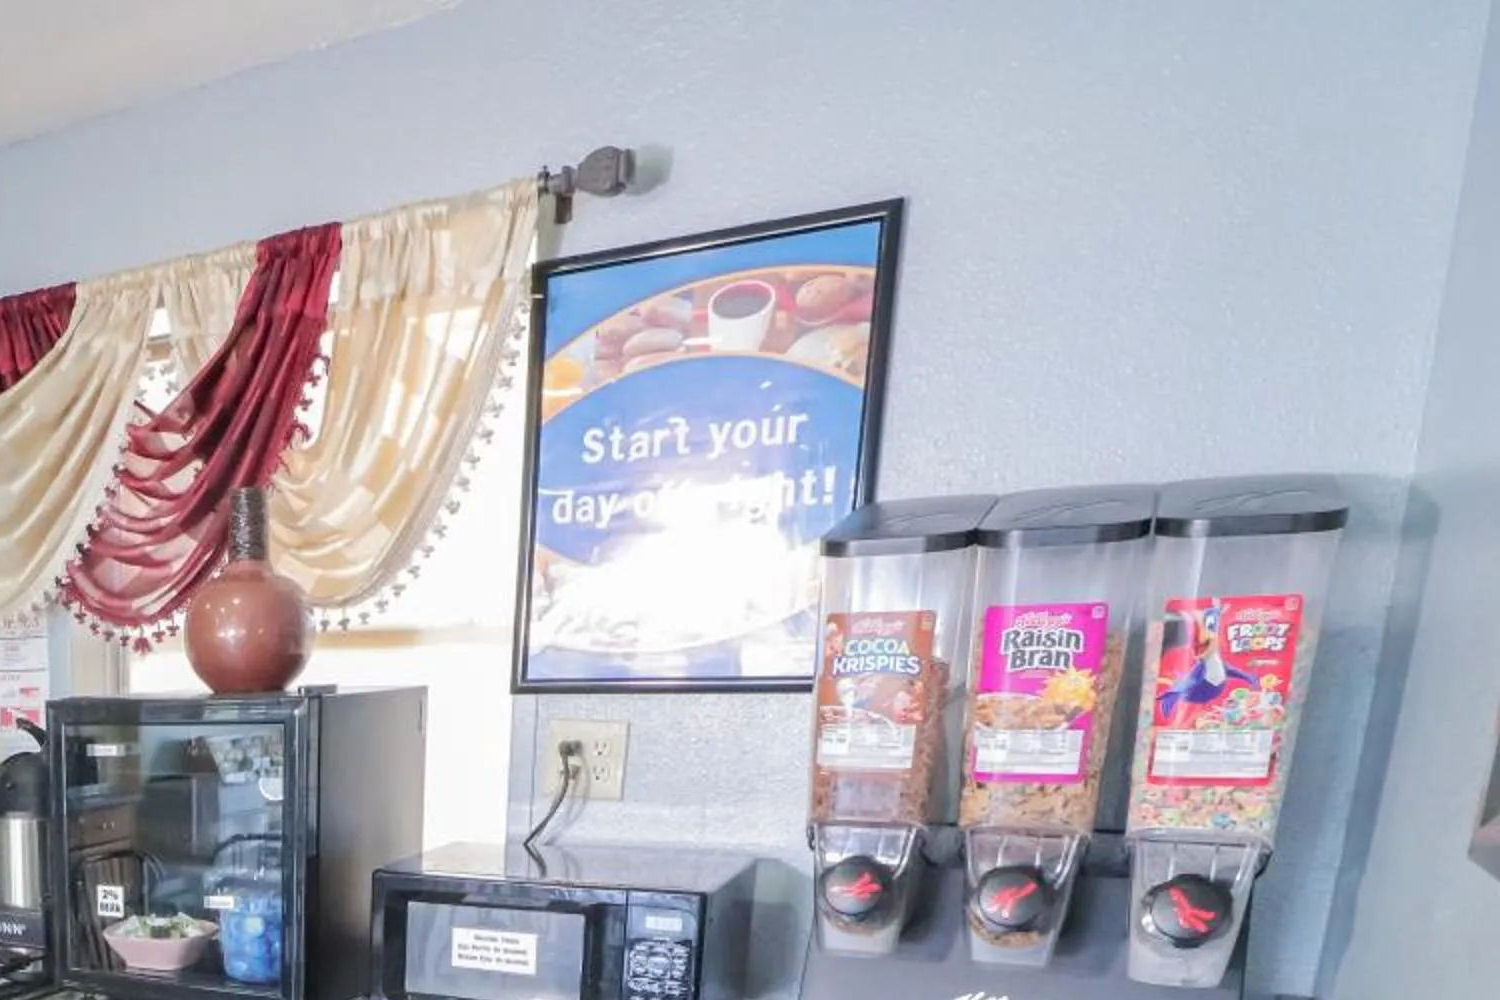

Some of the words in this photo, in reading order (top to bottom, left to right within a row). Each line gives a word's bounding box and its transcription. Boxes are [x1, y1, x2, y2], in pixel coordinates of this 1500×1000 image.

[581, 417, 690, 464] Start
[708, 413, 808, 460] your
[551, 489, 619, 529] day
[844, 637, 911, 656] COCOA
[1003, 629, 1082, 651] Raisin
[832, 655, 921, 675] KRISPIES
[1010, 650, 1071, 669] Bran
